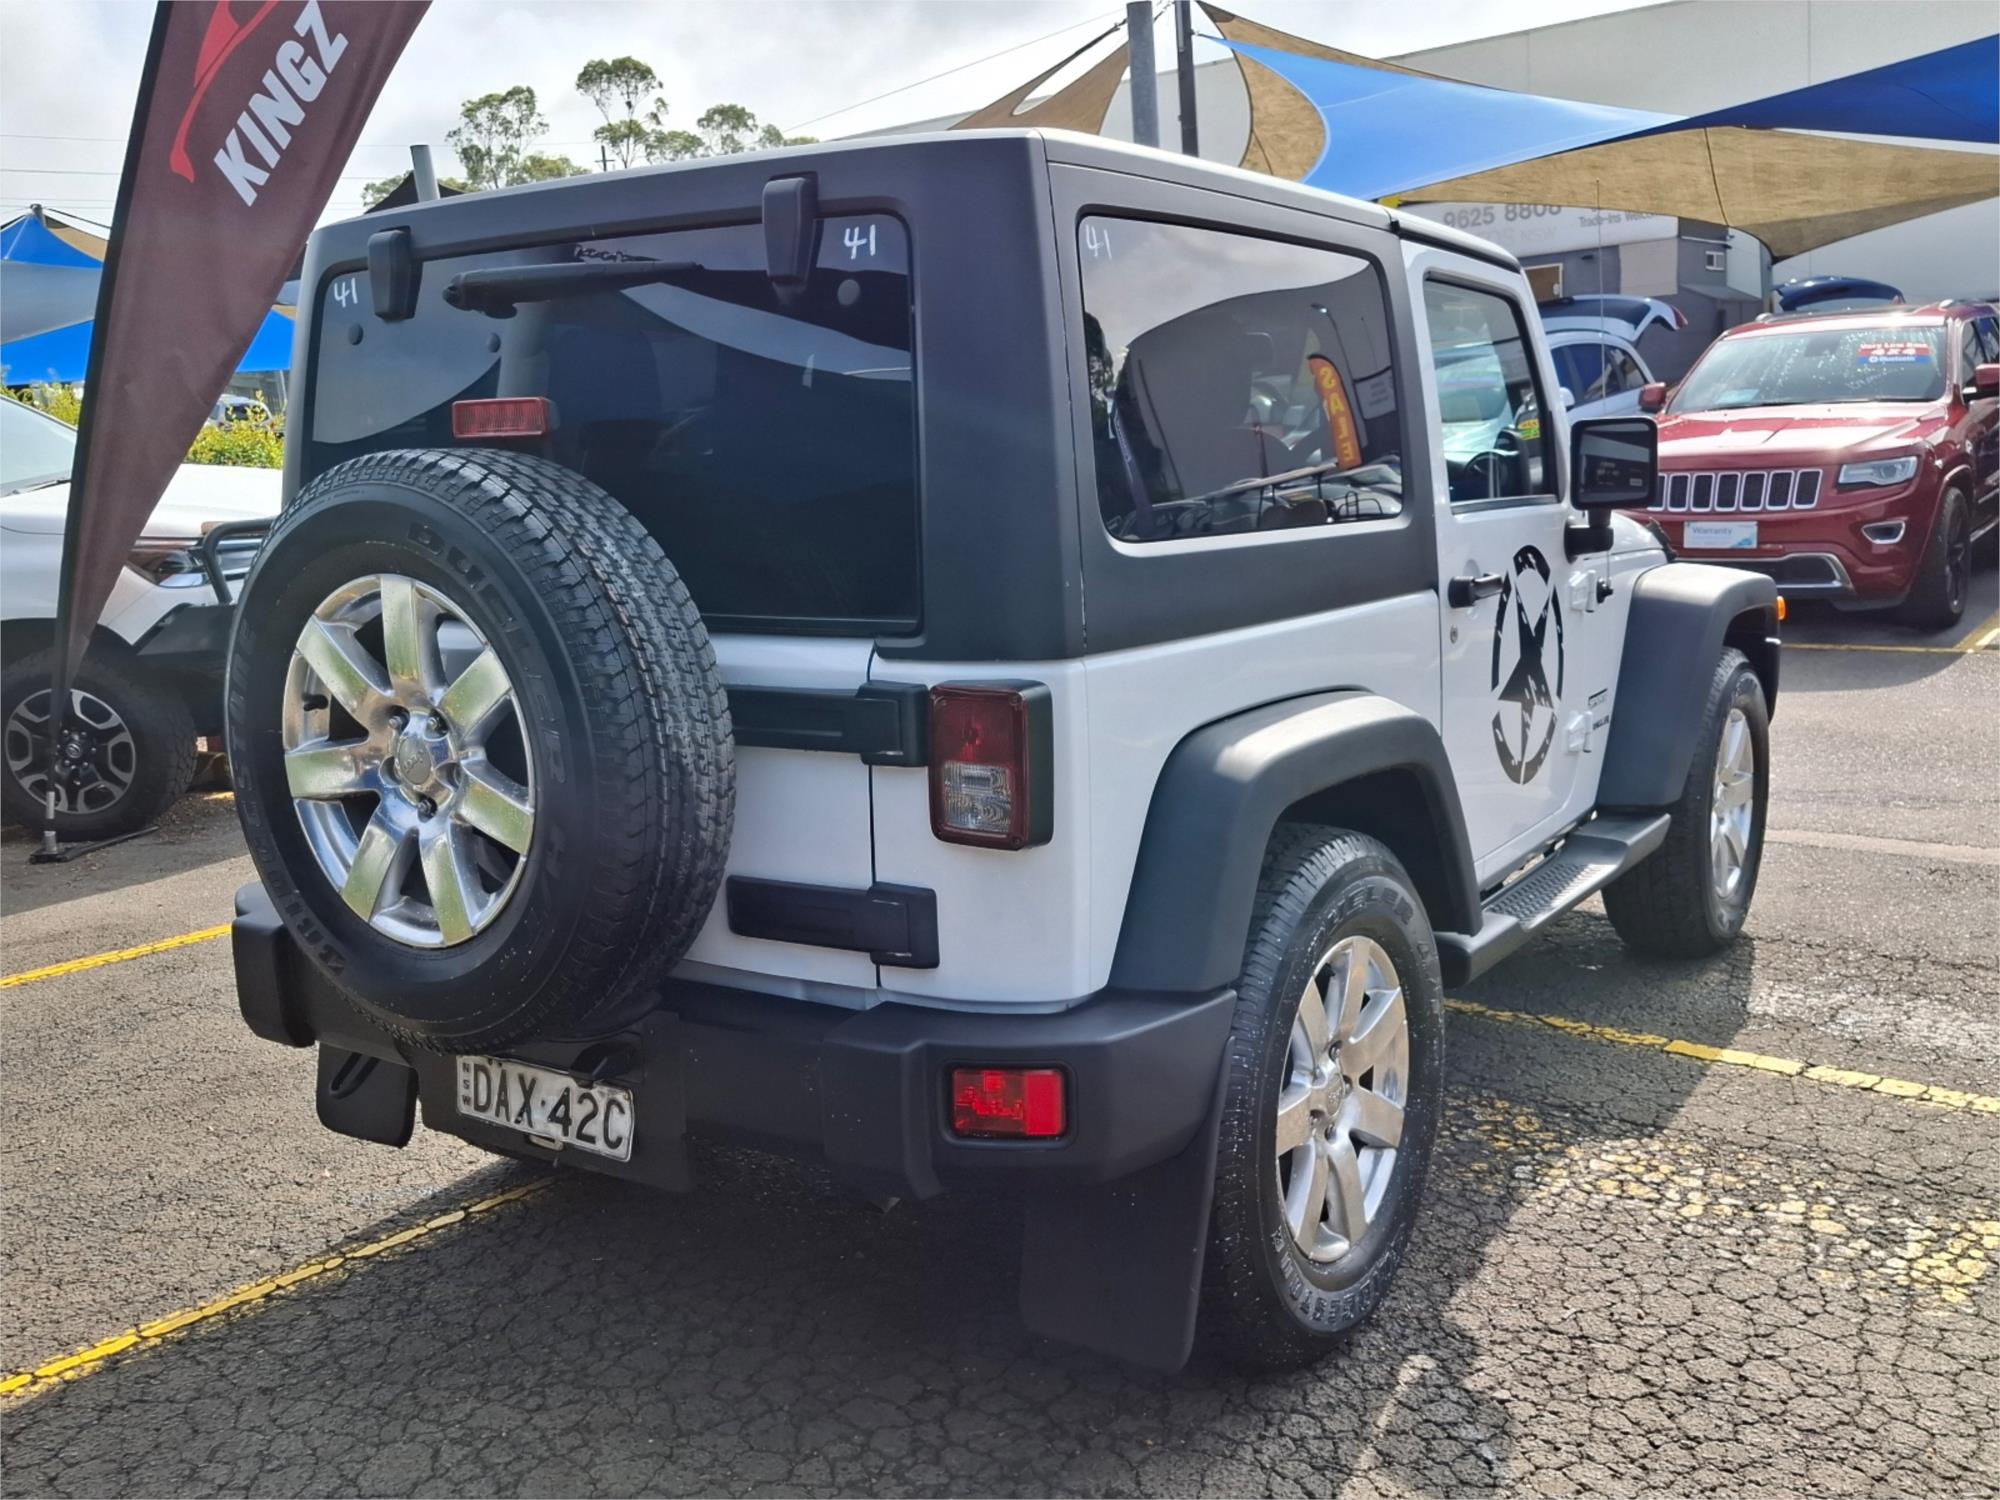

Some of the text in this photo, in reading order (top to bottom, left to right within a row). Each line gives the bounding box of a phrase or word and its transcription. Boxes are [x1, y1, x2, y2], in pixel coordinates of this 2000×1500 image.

[213, 0, 349, 207] KINGZ
[1443, 206, 1495, 229] 9625
[844, 224, 876, 260] 41
[1086, 224, 1112, 260] 41
[334, 277, 358, 308] 41
[462, 1062, 472, 1107] NSW
